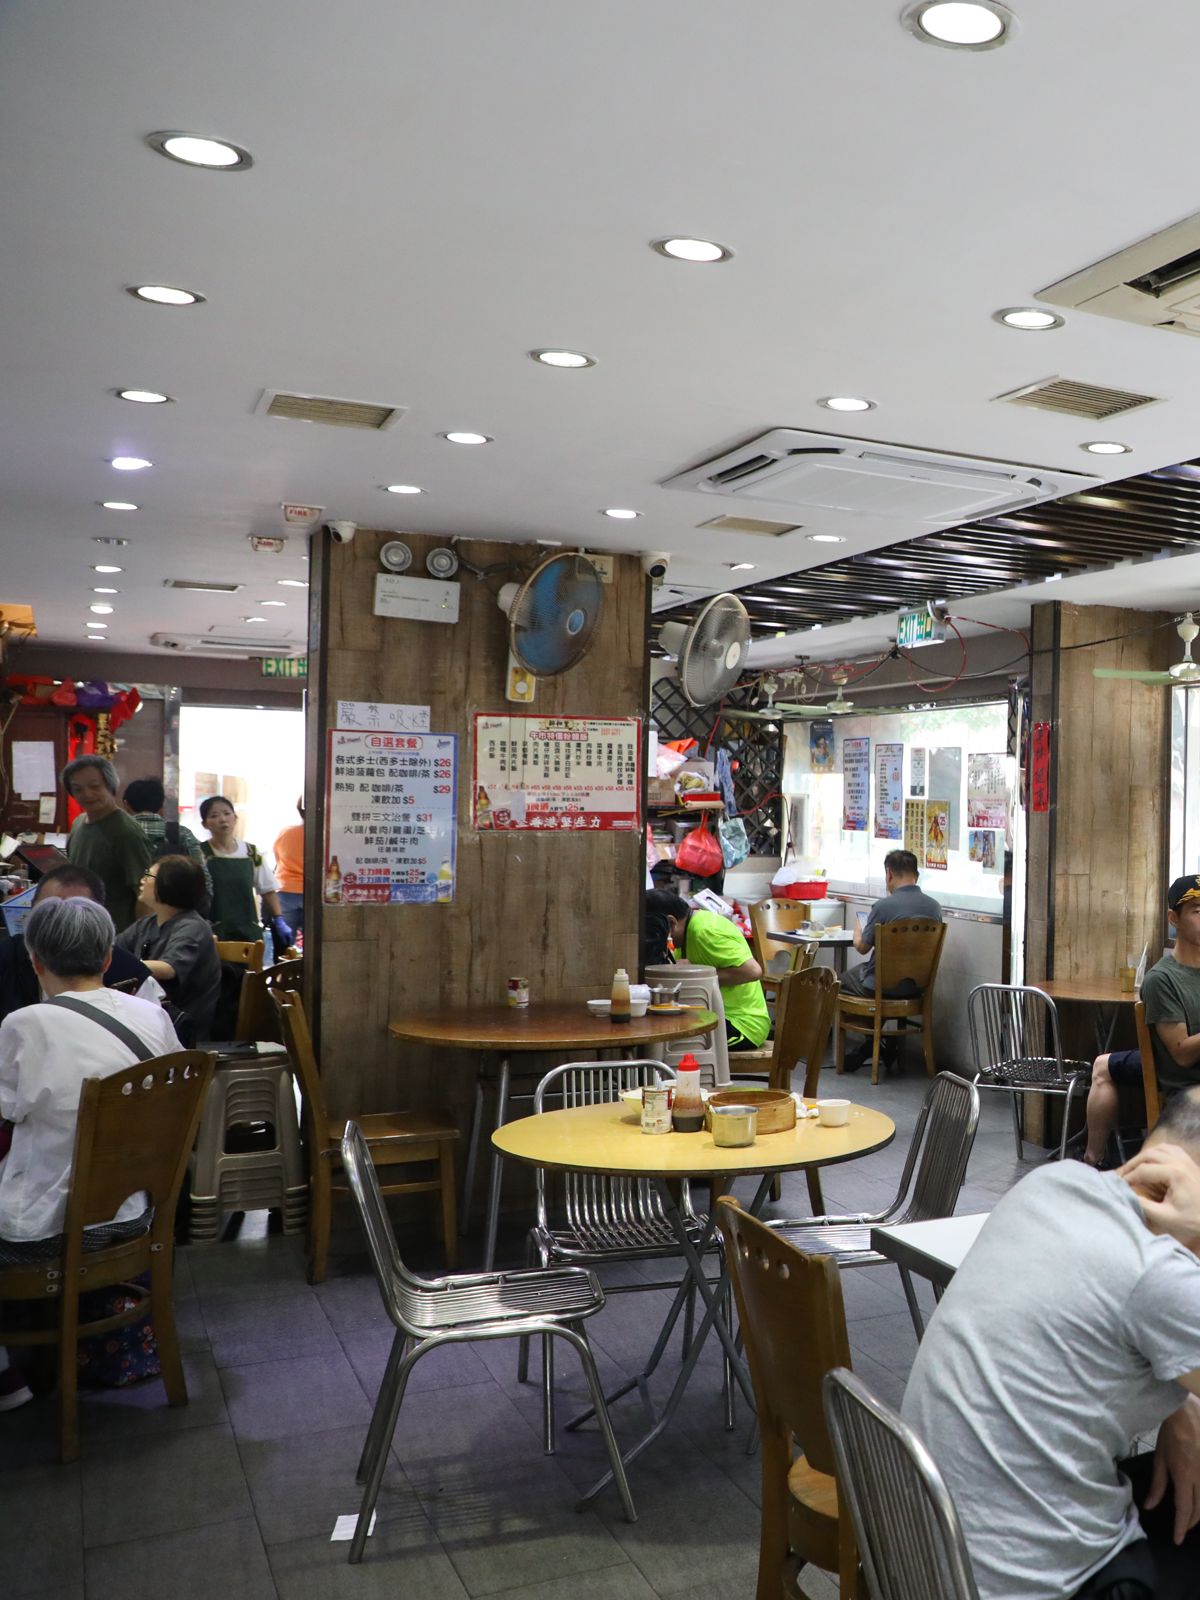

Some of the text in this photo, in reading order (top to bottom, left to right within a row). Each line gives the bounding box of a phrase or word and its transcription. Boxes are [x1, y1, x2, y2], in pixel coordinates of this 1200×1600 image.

[898, 613, 916, 645] EXIT
[264, 657, 295, 678] EXIT
[371, 736, 418, 750] 自選套餐
[433, 758, 452, 768] $26
[433, 769, 452, 779] $26
[433, 784, 452, 795] $29
[402, 795, 416, 806] $5
[415, 812, 433, 823] $31
